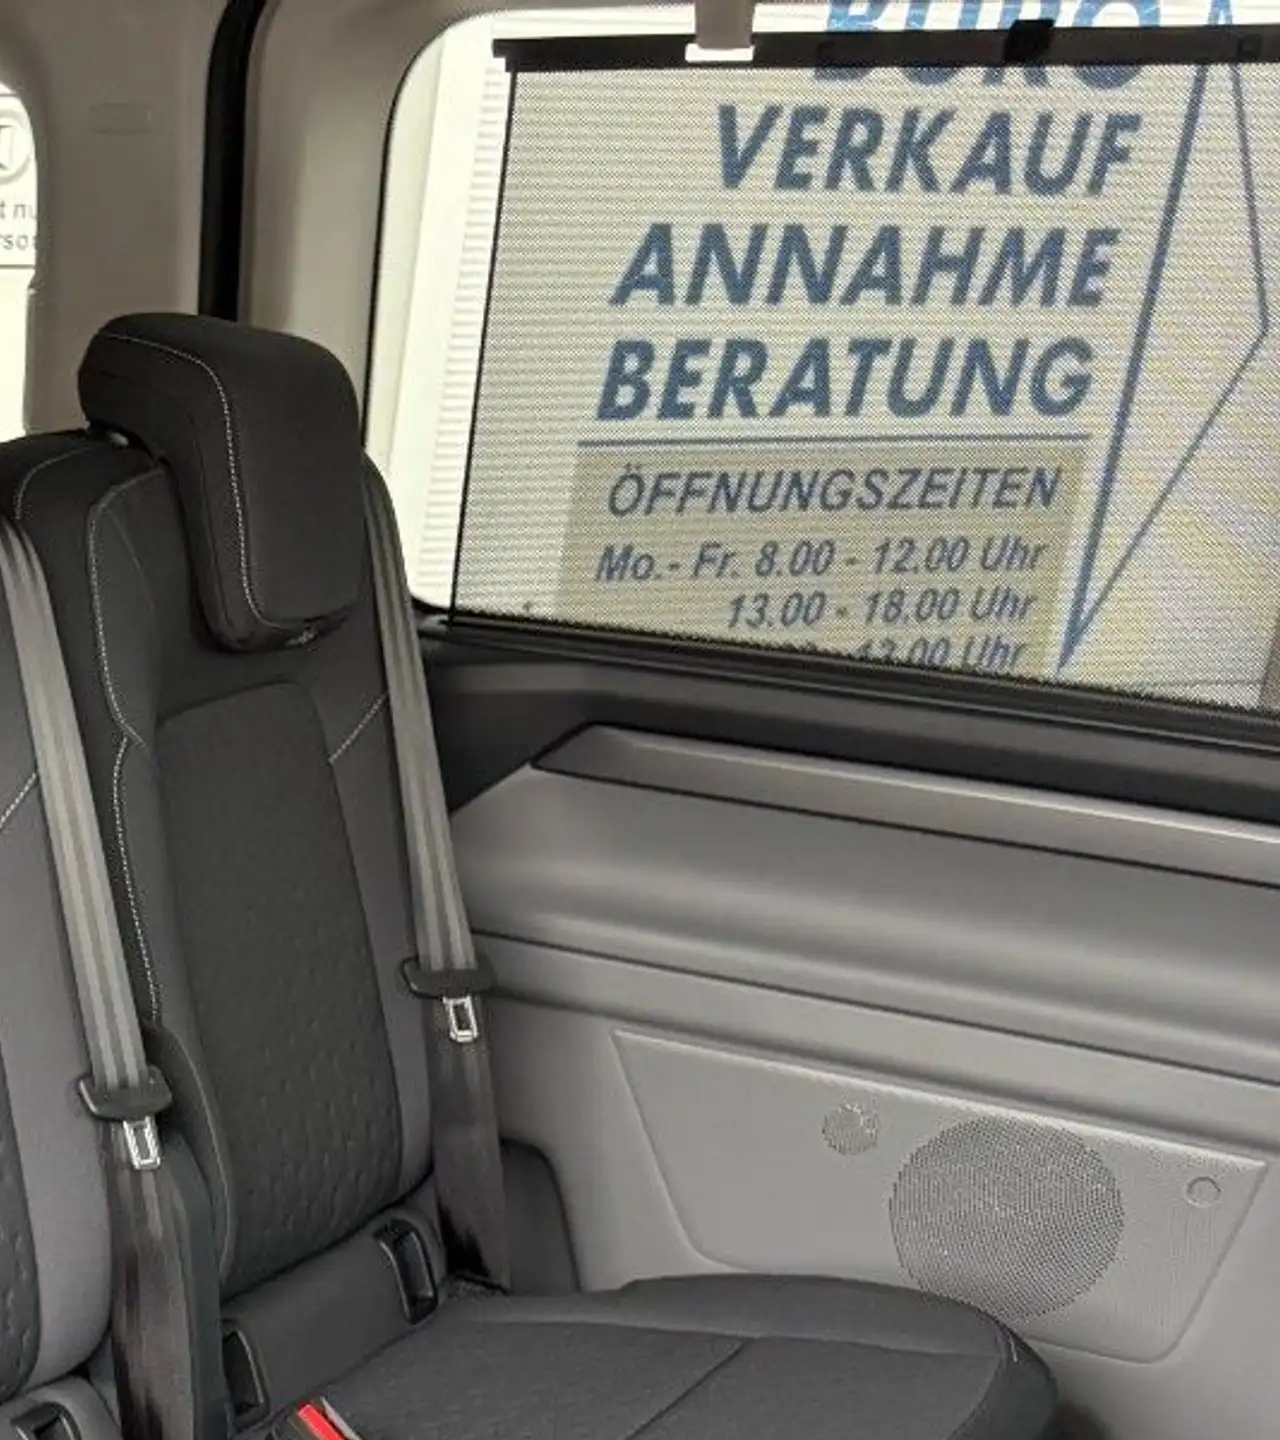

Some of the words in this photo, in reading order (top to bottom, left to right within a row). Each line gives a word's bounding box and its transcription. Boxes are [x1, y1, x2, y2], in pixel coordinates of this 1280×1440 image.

[716, 104, 1143, 196] VERKAUF
[609, 222, 1121, 309] ANNAHME
[595, 336, 1094, 422] BERATUNG
[608, 462, 1062, 517] ÖFFNUNGSZEITEN
[691, 542, 739, 579] Fr.
[754, 538, 836, 577] 8.00
[873, 536, 970, 576] 12.00
[980, 534, 1048, 573] Uhr
[727, 590, 827, 630] 13.00
[864, 587, 960, 625] 18.00
[969, 586, 1036, 624] Uhr
[960, 634, 1028, 672] Uhr
